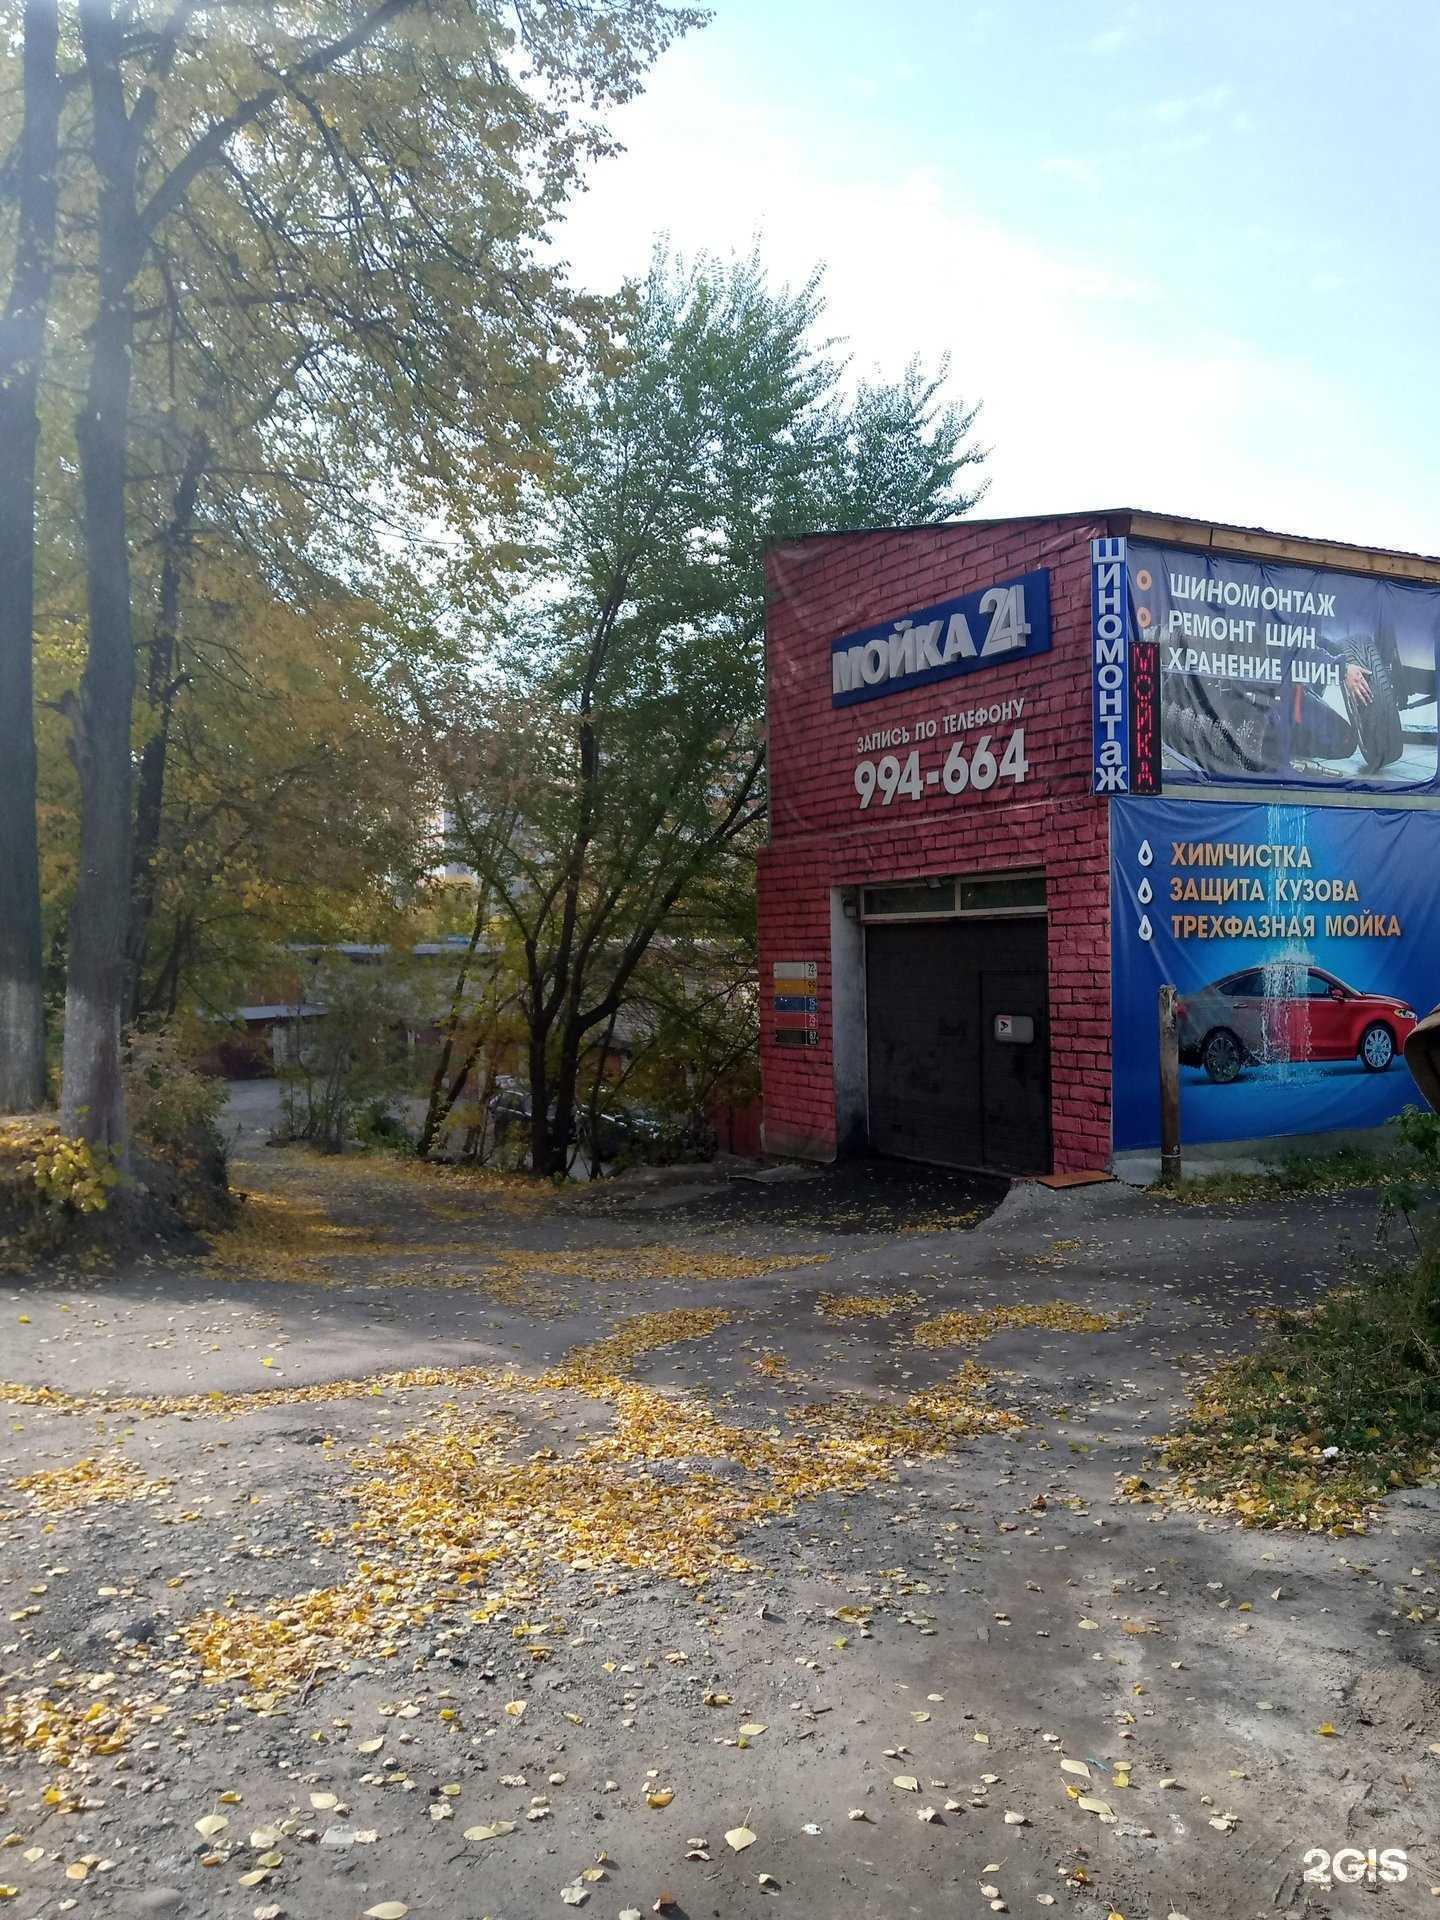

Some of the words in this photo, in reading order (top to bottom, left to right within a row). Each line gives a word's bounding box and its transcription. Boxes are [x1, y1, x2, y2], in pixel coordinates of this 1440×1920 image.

[1169, 573, 1336, 618] ШИНОМОНТАЖ
[832, 614, 977, 694] МОЙКА
[978, 584, 1032, 657] 24
[1168, 610, 1256, 645] РЕМОНТ
[1265, 622, 1316, 650] ШИН
[1167, 646, 1282, 682] ХРАНЕНИЕ
[1290, 660, 1340, 686] ШИН
[857, 727, 909, 753] ЗАПИСЬ
[915, 721, 937, 739] ПО
[943, 698, 1025, 735] ТЕЛЕФОНУ
[1133, 646, 1154, 786] МОЙКА
[854, 728, 1029, 809] 994-664
[1170, 842, 1312, 868] ХИМЧИСТКА
[1169, 877, 1265, 905] ЗАЩИТА
[1274, 879, 1360, 902] КУЗОВА
[1171, 914, 1315, 938] ТРЕХФАЗНАЯ
[1326, 909, 1401, 937] МОЙКА
